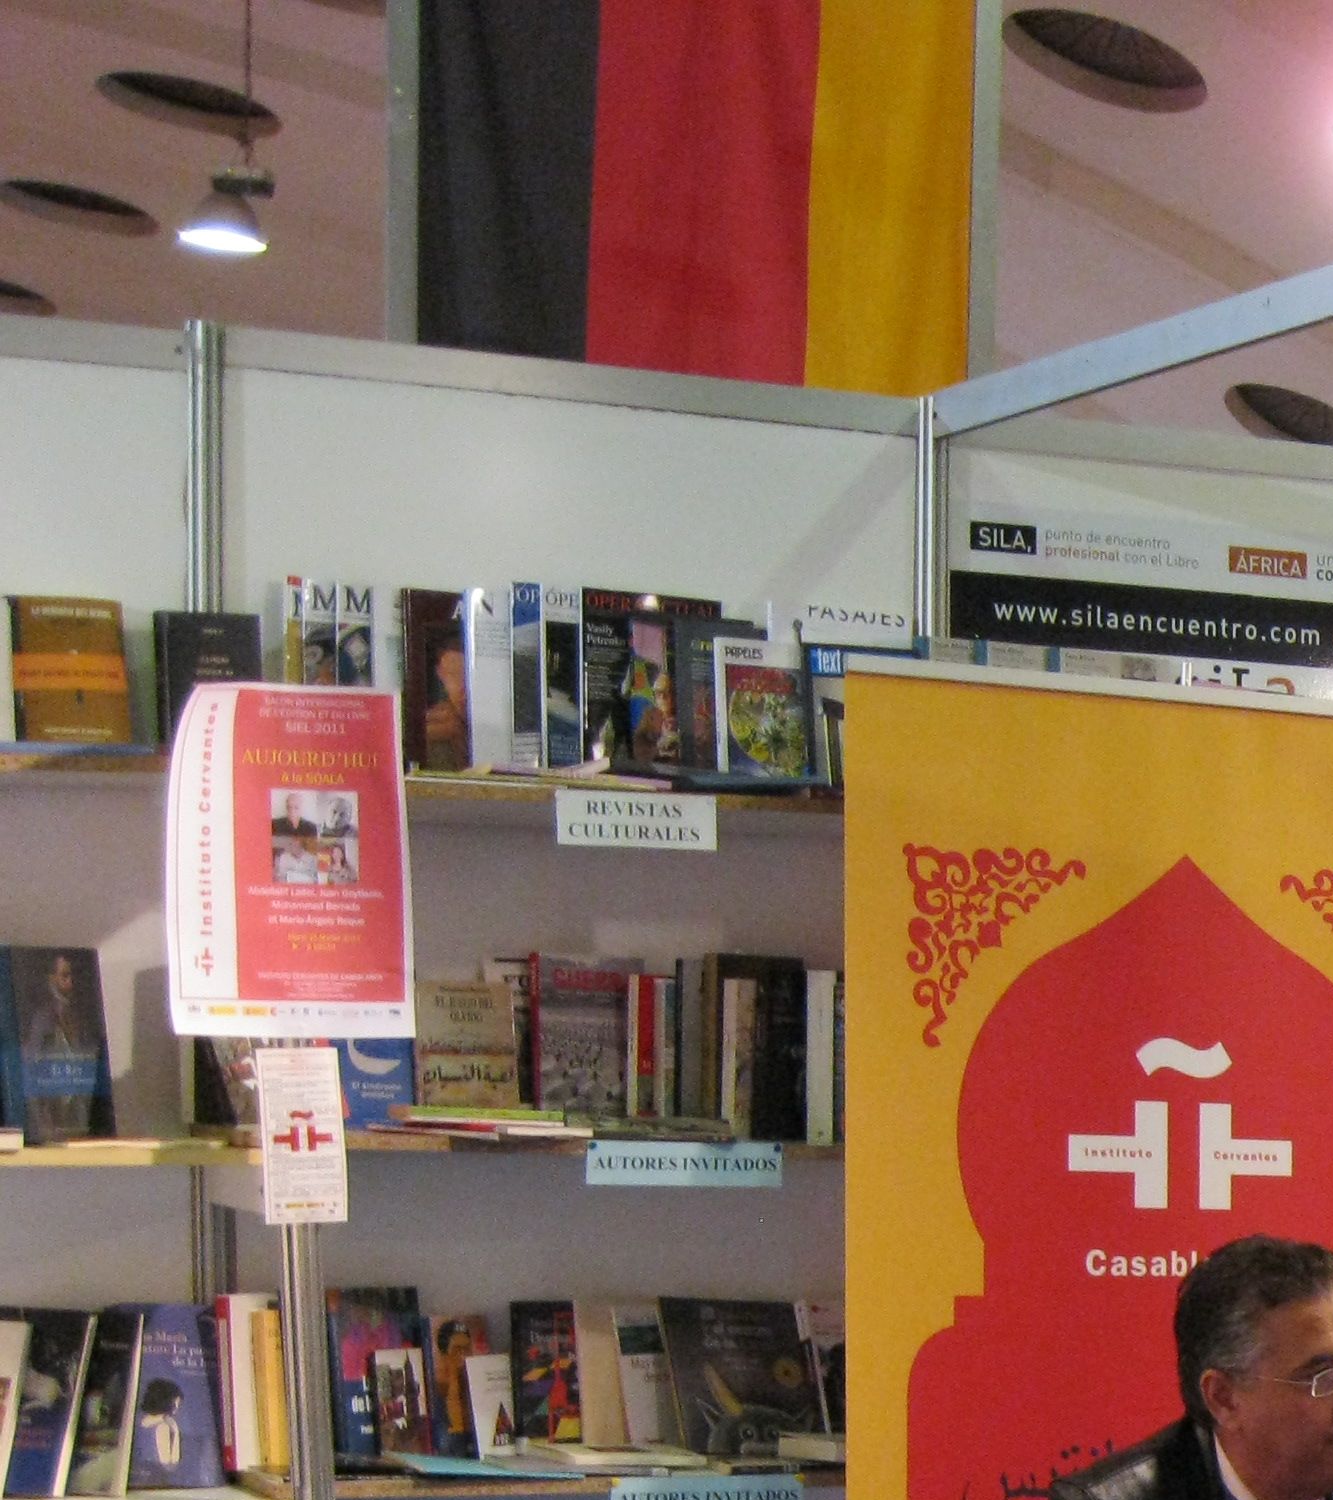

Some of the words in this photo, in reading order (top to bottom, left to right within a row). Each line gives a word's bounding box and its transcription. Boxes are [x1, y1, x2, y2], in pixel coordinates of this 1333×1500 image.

[979, 526, 1032, 553] SILA,
[1045, 529, 1082, 543] punto
[1086, 531, 1101, 544] de
[1105, 535, 1170, 550] encuentro
[1045, 545, 1120, 562] profesional
[1124, 553, 1147, 565] con
[1150, 554, 1162, 567] el
[1236, 549, 1302, 577] ÁFRICA
[993, 602, 1321, 646] www.silaencuentro.com
[586, 800, 683, 819] REVISTAS
[568, 822, 700, 842] CULTURALES
[595, 1156, 678, 1172] AUTORES
[683, 1157, 777, 1173] INVITADOS
[1084, 1147, 1153, 1159] Instituto
[1213, 1150, 1278, 1162] Cervantes
